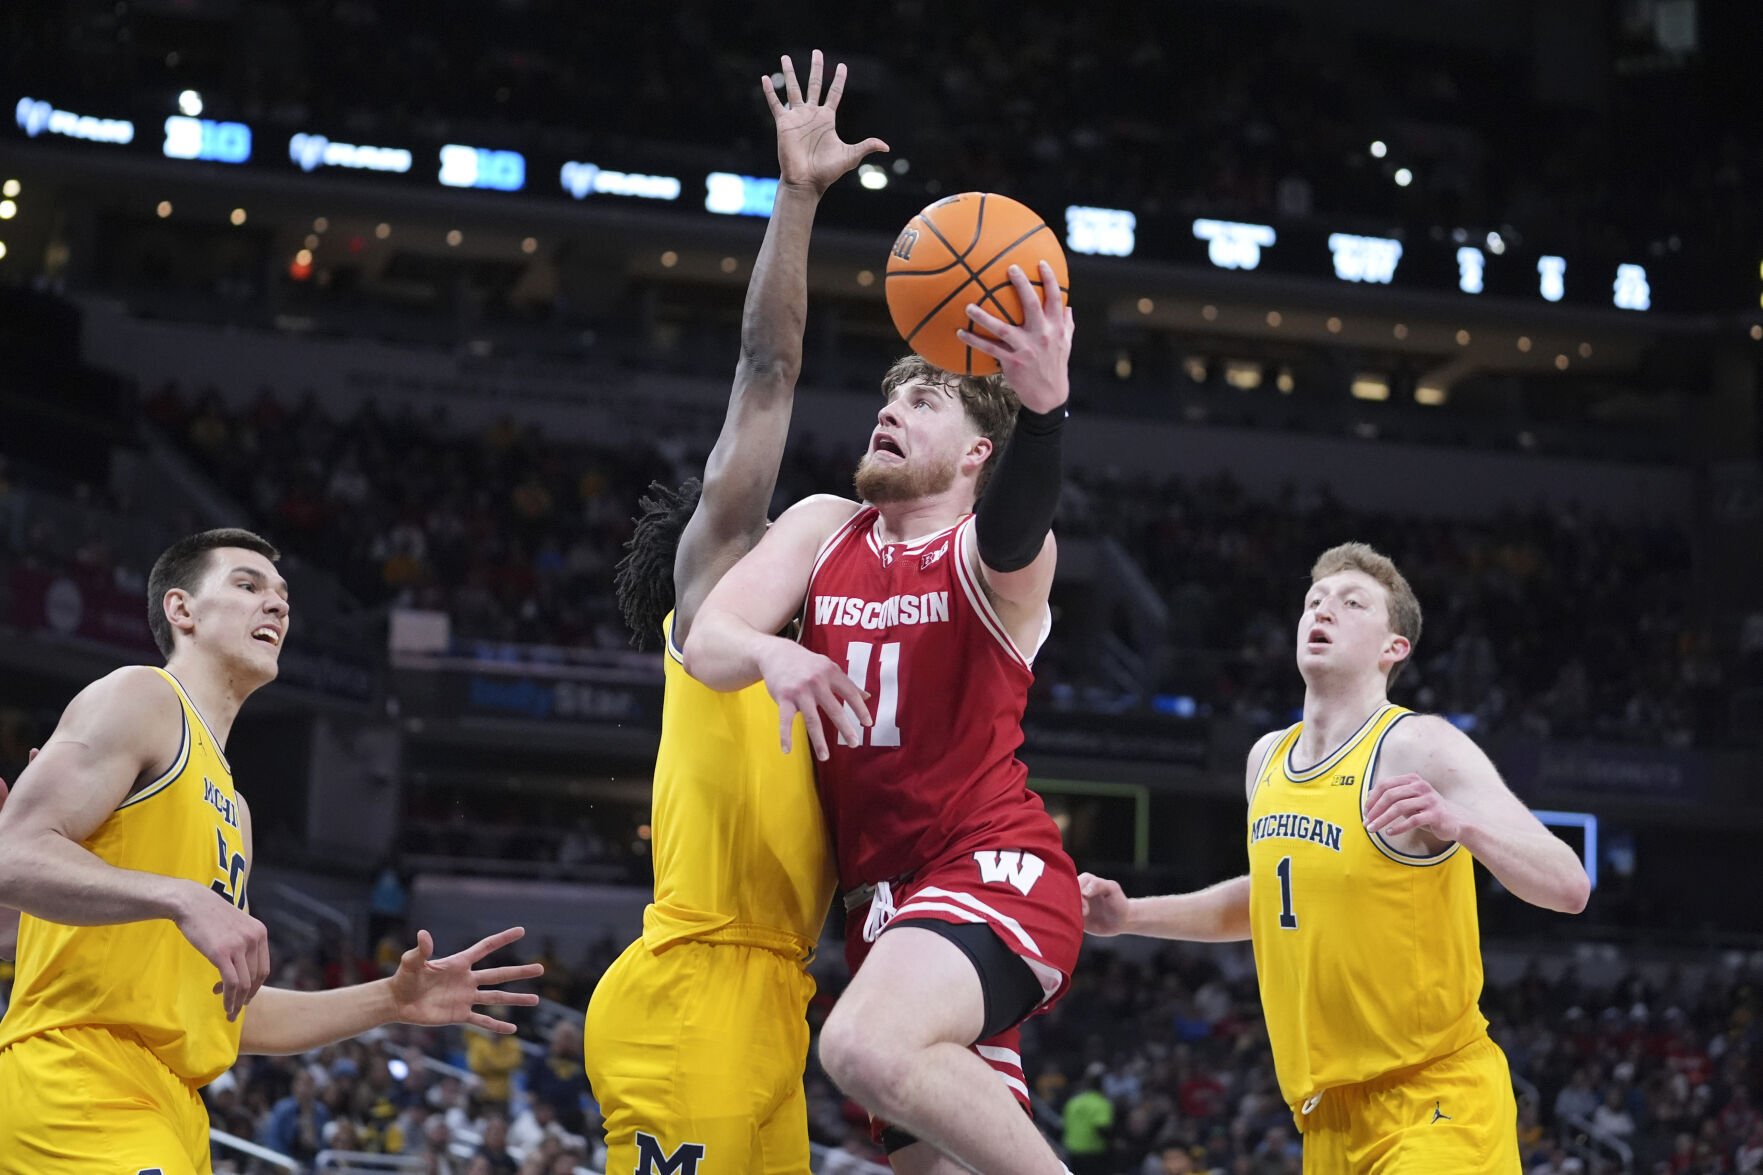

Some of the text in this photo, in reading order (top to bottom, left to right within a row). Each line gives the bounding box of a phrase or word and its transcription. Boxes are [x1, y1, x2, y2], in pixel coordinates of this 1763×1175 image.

[814, 590, 950, 630] WISCONSIN
[837, 641, 901, 747] 11
[1251, 814, 1342, 852] MICHIGAN
[972, 848, 1047, 897] W
[1276, 855, 1299, 931] 1
[633, 1129, 707, 1175] M
